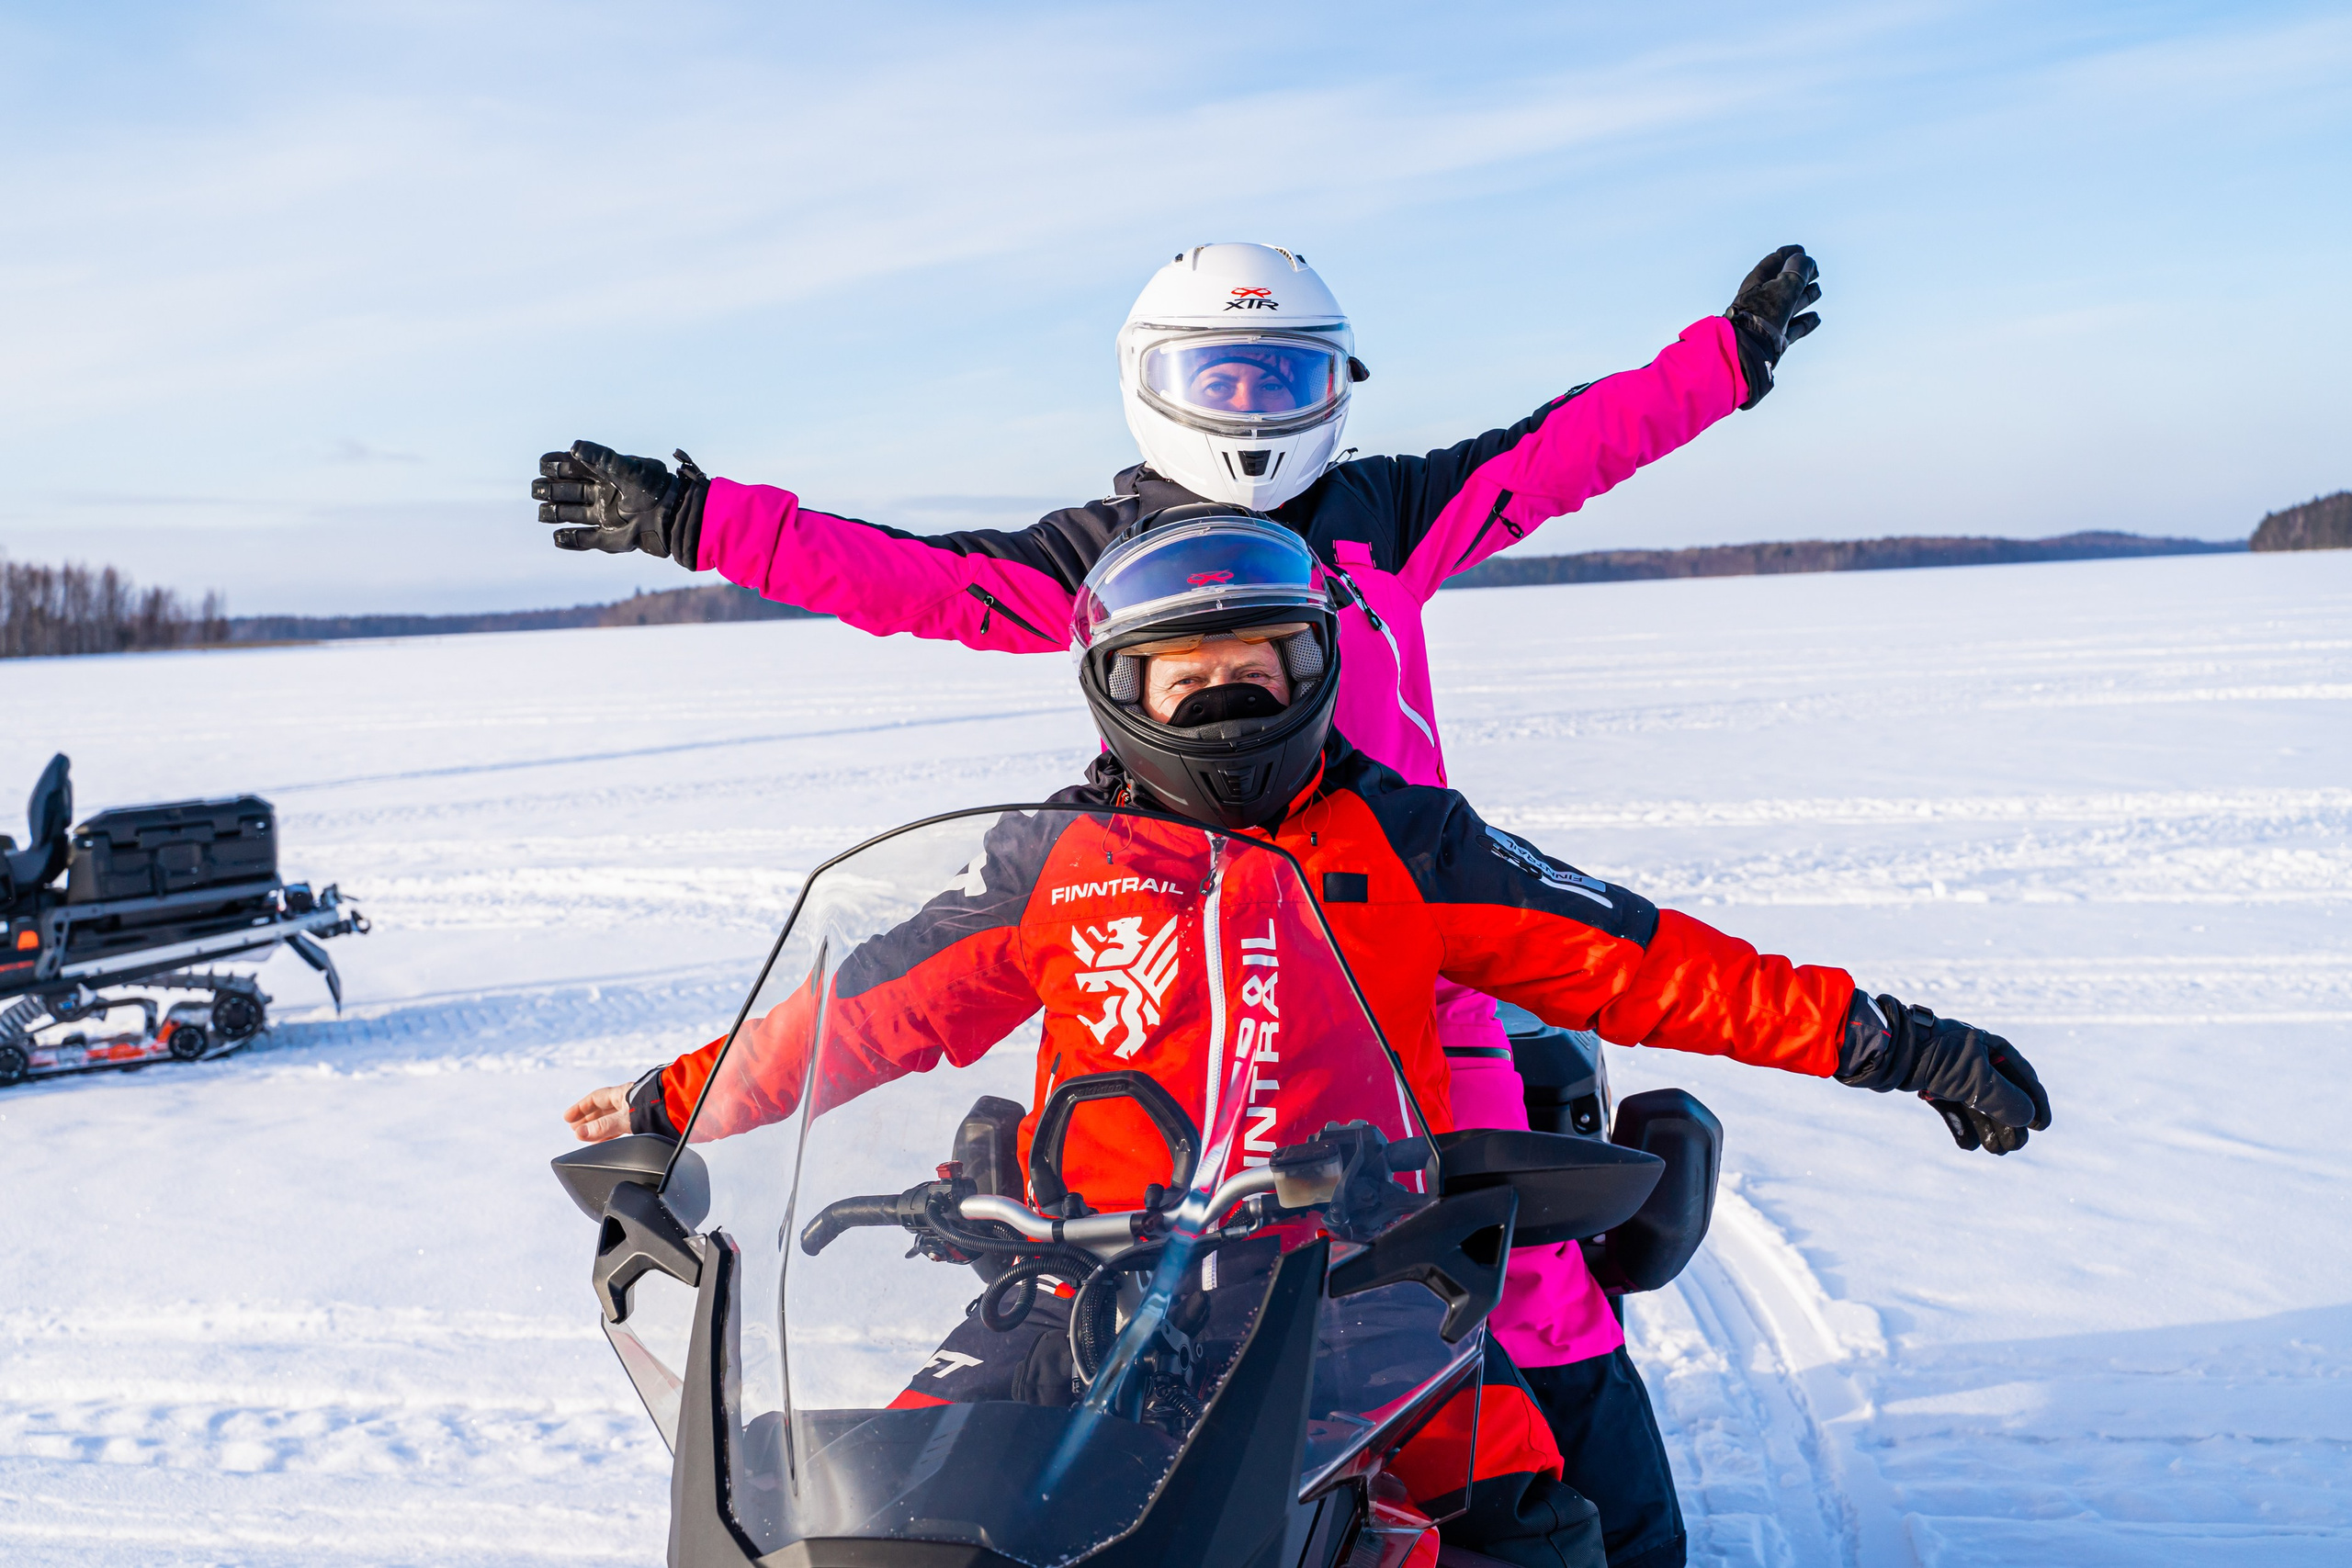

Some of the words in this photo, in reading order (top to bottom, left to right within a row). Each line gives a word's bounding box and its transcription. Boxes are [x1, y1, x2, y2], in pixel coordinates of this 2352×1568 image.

[1223, 299, 1279, 311] XTR
[1506, 839, 1583, 883] FINNTRAIL
[1051, 877, 1184, 906] FINNTRAIL
